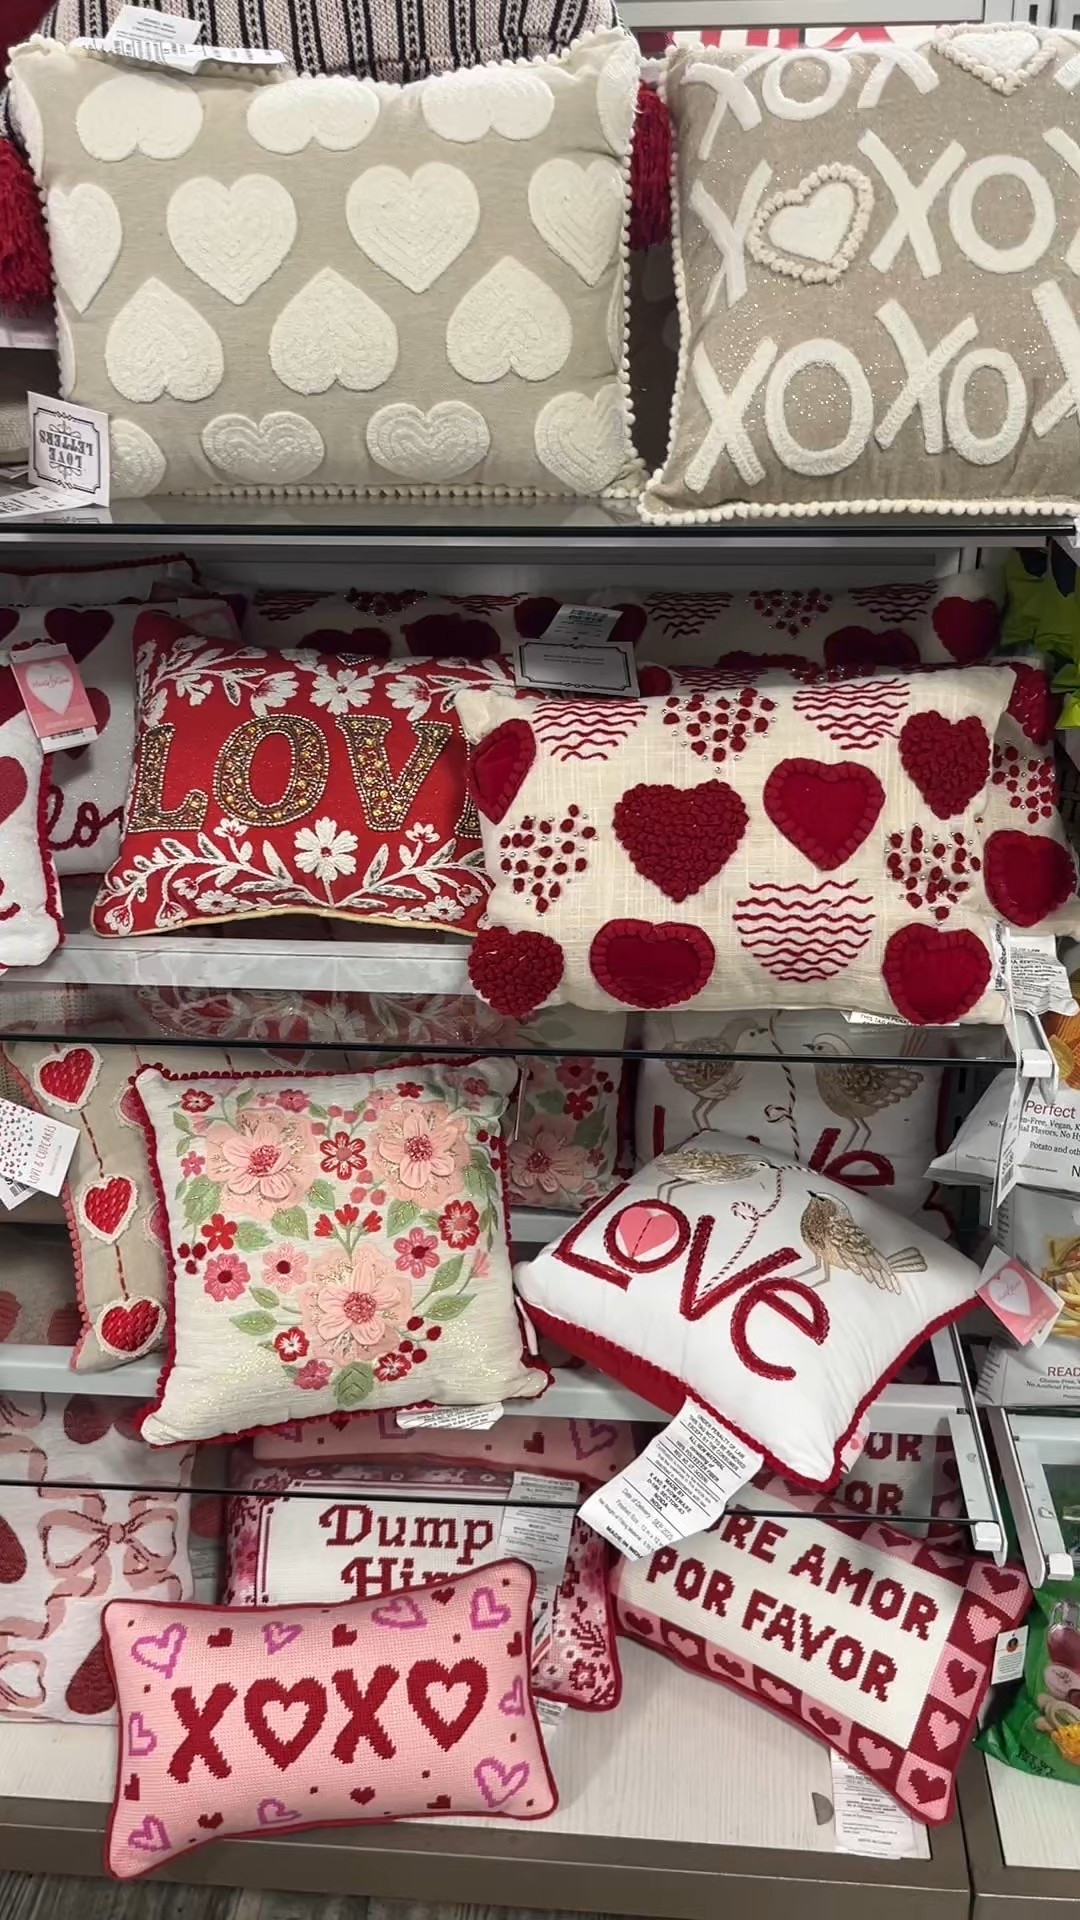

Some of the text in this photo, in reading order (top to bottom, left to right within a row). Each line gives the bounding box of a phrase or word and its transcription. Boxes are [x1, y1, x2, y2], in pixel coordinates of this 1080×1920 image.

[39, 429, 93, 456] LETTERS
[49, 447, 82, 468] LOVE
[127, 713, 482, 839] LOV
[1024, 1100, 1076, 1119] Perfect
[1054, 1146, 1068, 1154] and
[319, 1504, 493, 1565] Dump
[788, 1543, 939, 1641] AMOR
[646, 1545, 898, 1702] POR FAVOR
